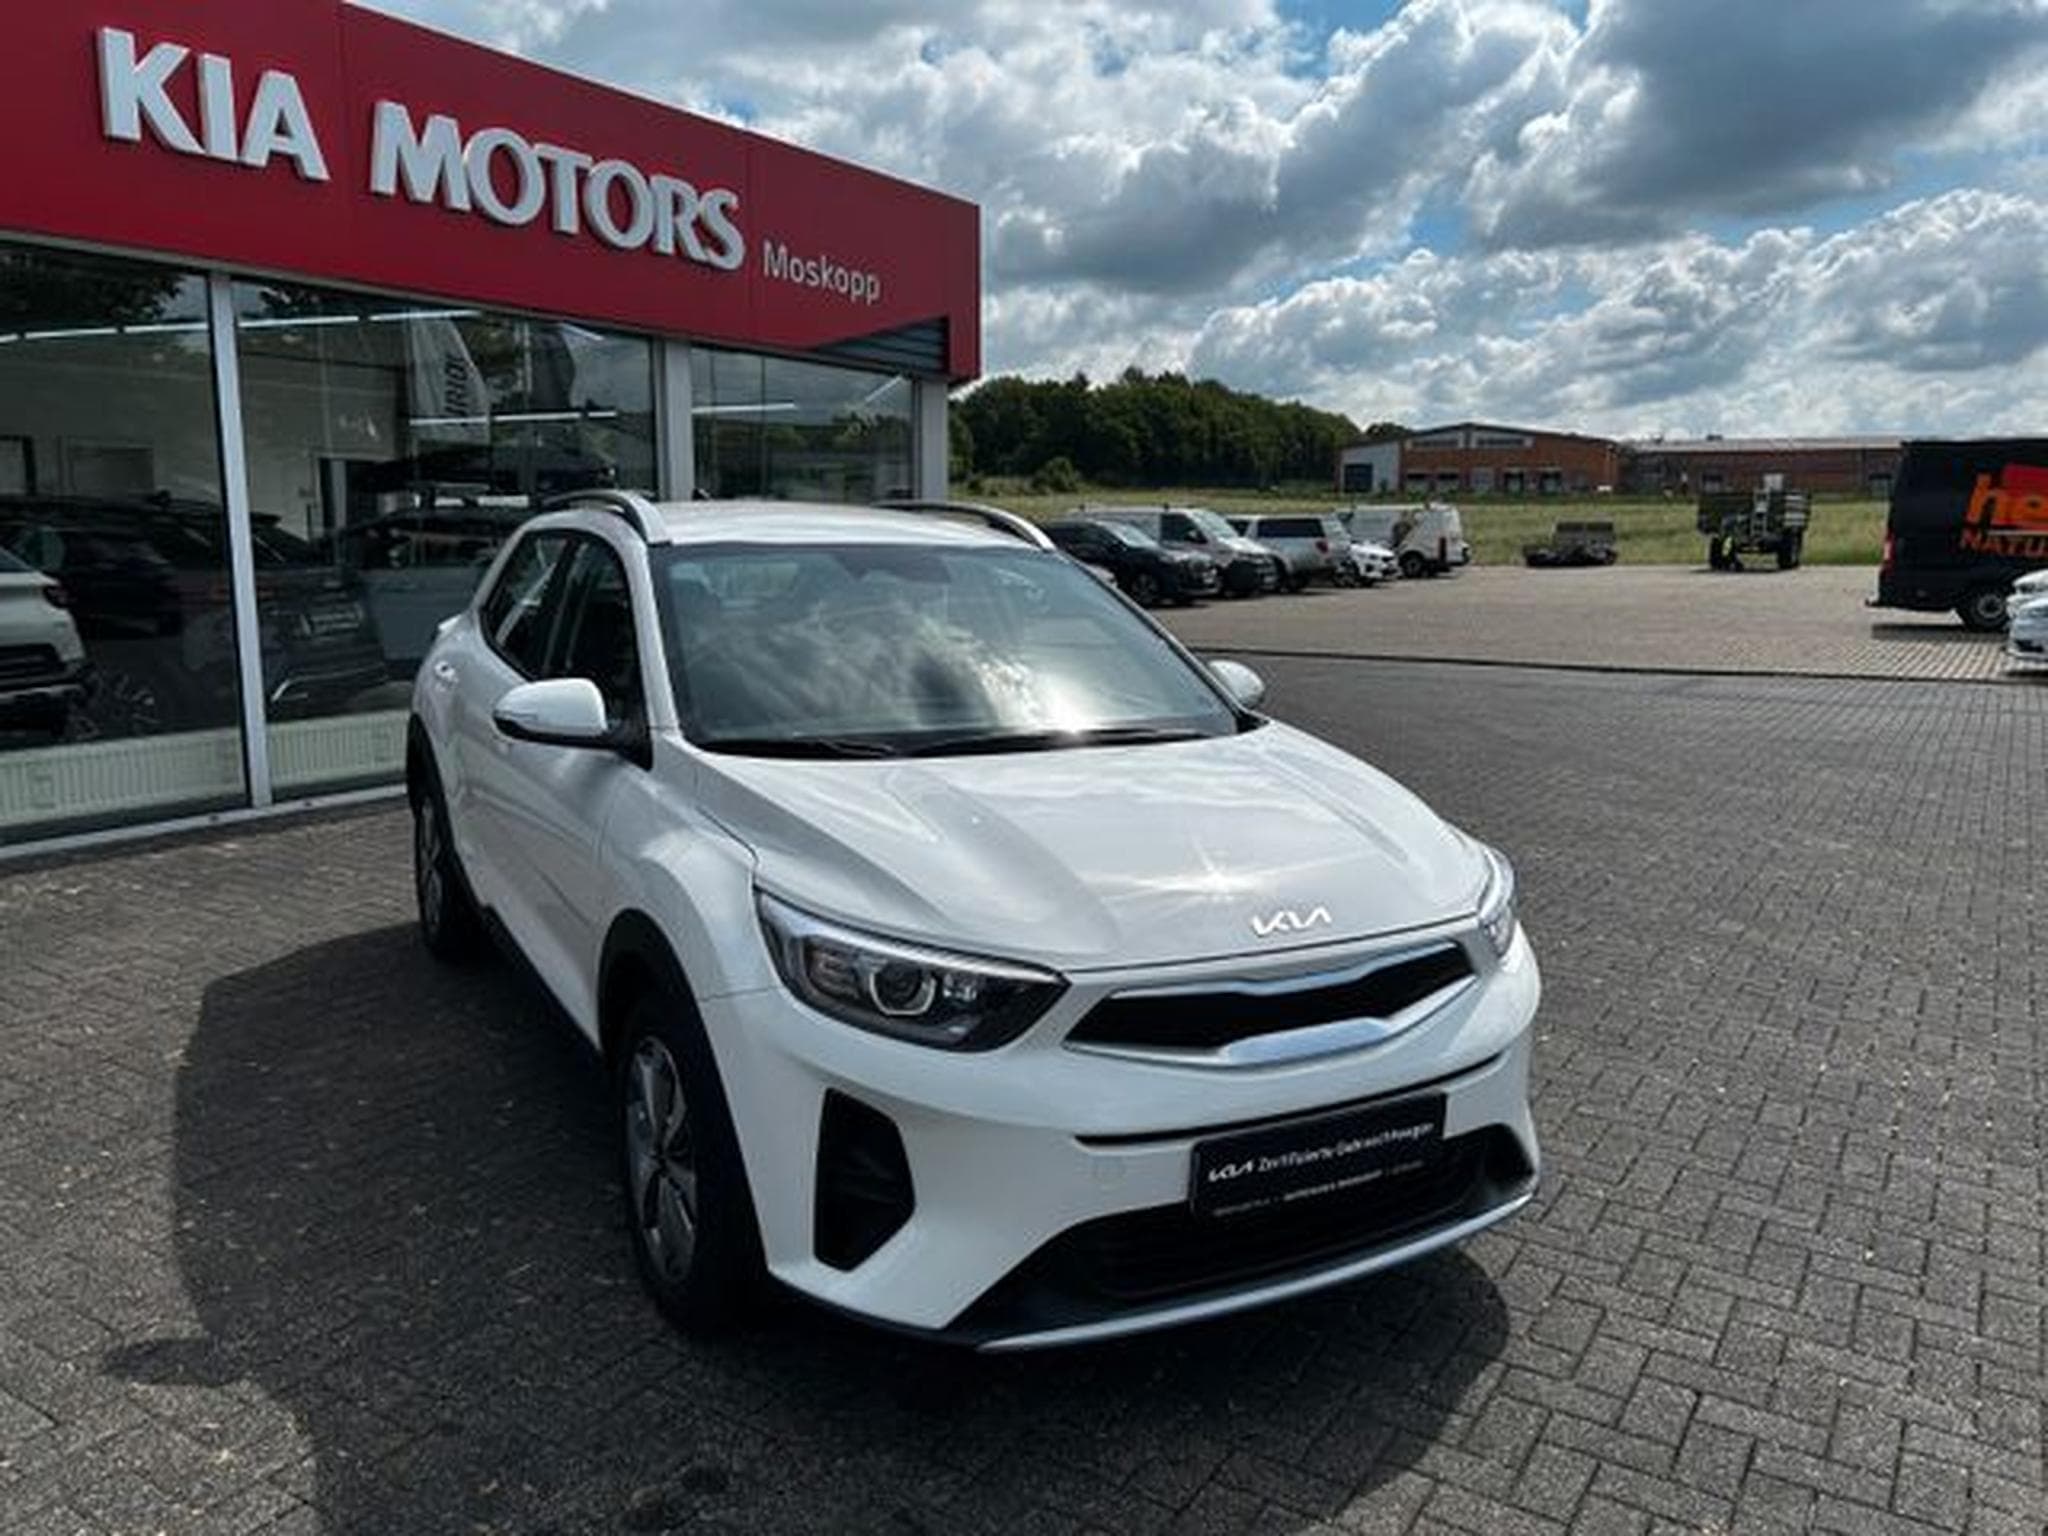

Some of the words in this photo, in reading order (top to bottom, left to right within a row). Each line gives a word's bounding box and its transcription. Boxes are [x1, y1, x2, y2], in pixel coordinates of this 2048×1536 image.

[96, 27, 330, 181] KIA
[370, 100, 745, 271] MOTORS
[763, 239, 881, 306] Moskopp
[1252, 906, 1332, 935] KIA
